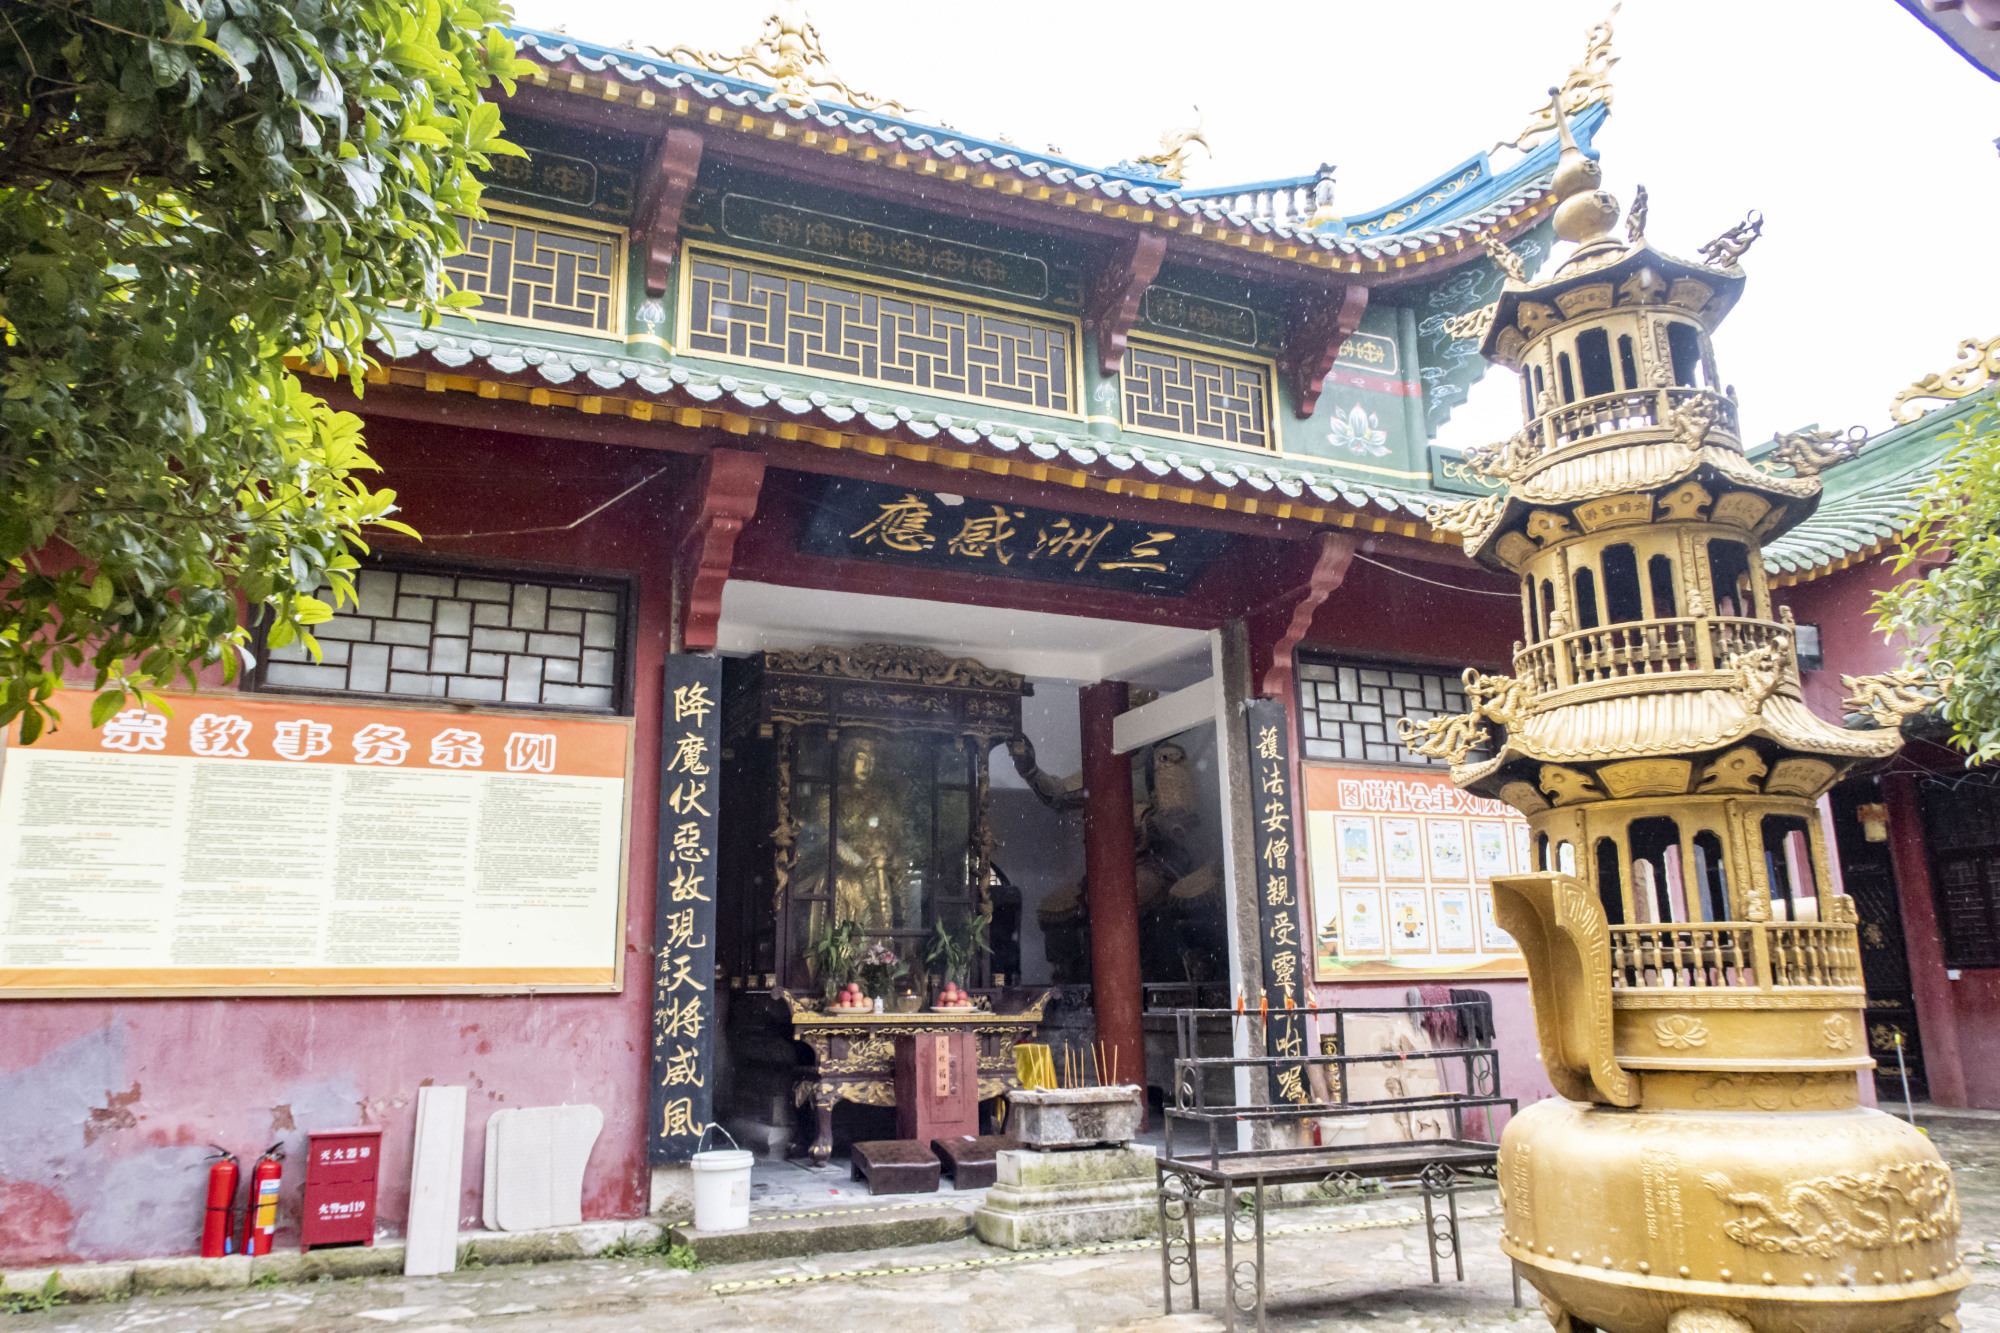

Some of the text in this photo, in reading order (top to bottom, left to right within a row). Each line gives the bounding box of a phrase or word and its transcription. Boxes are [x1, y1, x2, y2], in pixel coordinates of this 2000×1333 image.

[101, 709, 557, 773] 宗教事务条例
